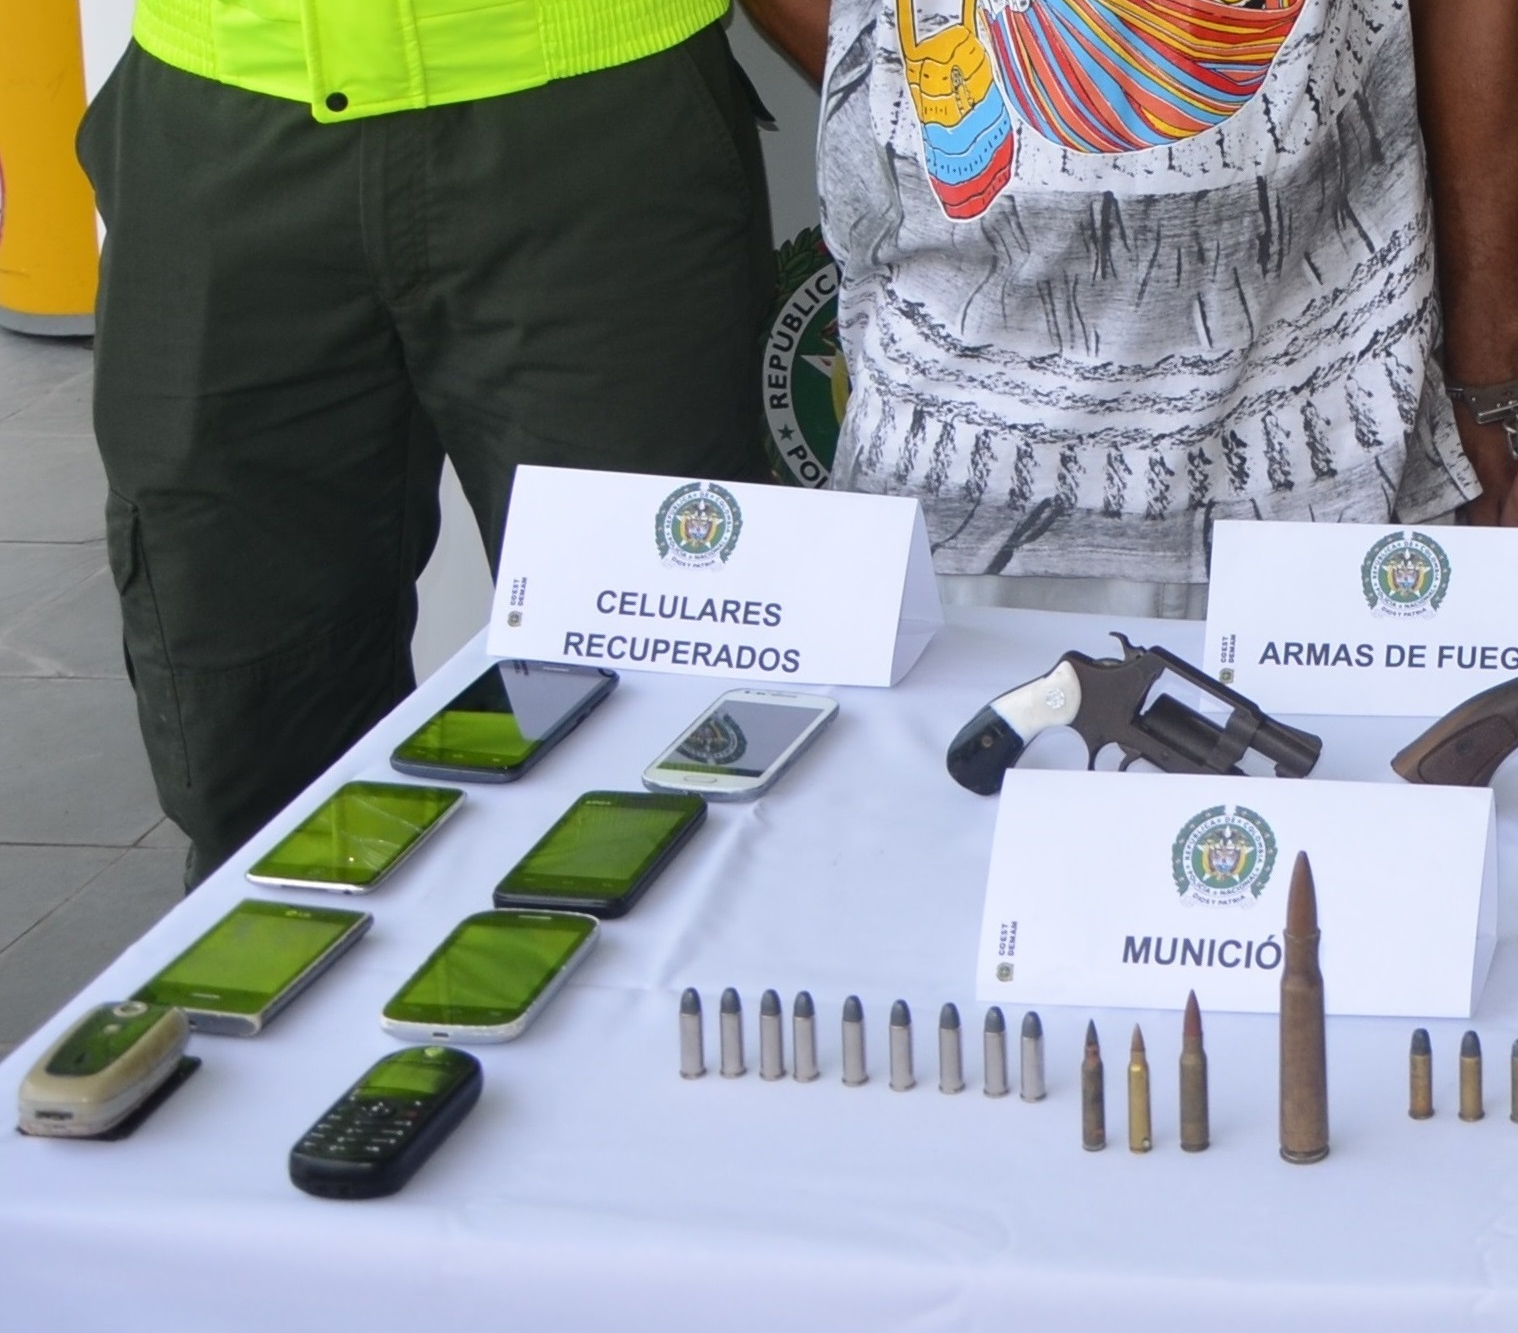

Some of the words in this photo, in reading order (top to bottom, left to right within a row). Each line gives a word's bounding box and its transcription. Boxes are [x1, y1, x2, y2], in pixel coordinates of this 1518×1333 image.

[767, 274, 837, 409] REPÚBLIC
[597, 590, 782, 627] CELULARES
[563, 631, 801, 673] RECUPERADOS
[1258, 641, 1374, 668] ARMAS
[1385, 644, 1427, 668] DE
[1122, 934, 1283, 970] MUNICIÓ
